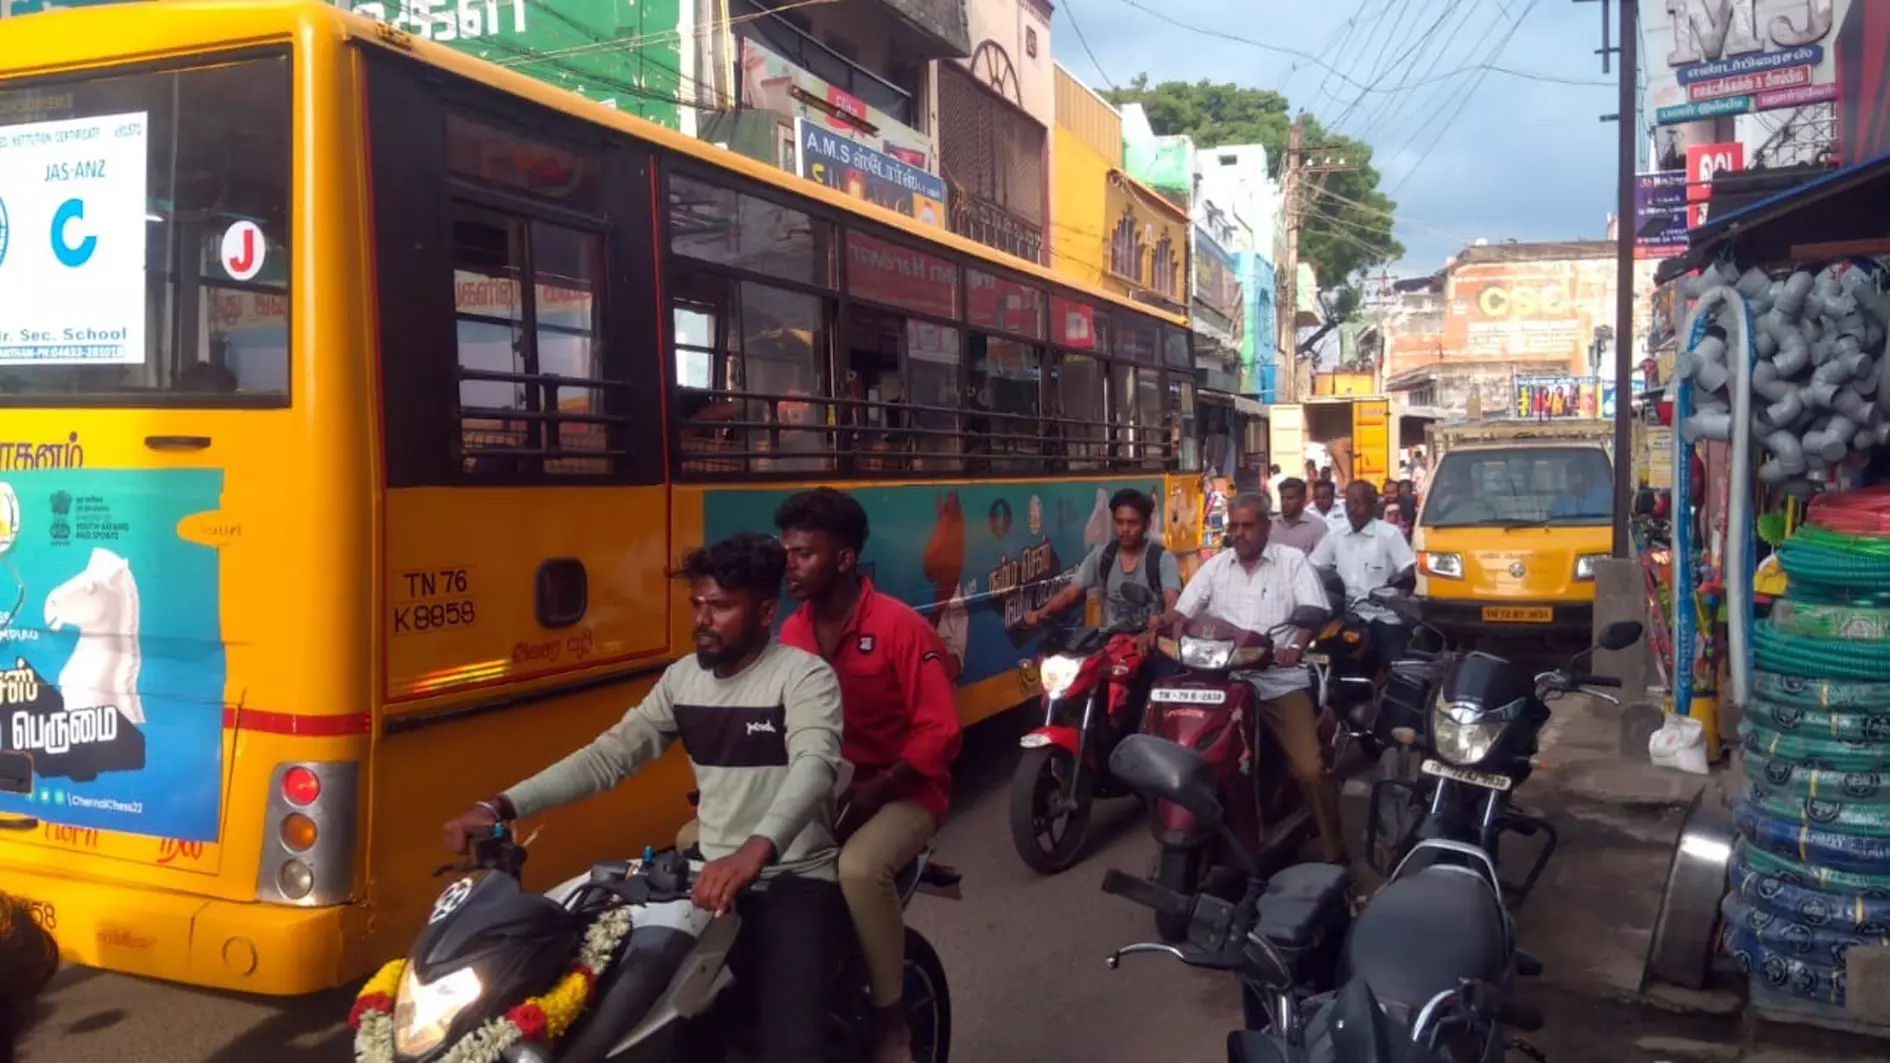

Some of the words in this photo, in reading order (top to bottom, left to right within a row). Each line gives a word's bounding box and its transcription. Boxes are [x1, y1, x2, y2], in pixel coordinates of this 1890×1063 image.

[806, 131, 850, 164] A.M.S
[229, 229, 254, 273] J
[63, 326, 127, 341] School
[404, 572, 437, 599] TN
[443, 569, 468, 593] 76
[12, 706, 118, 755] பெருமை
